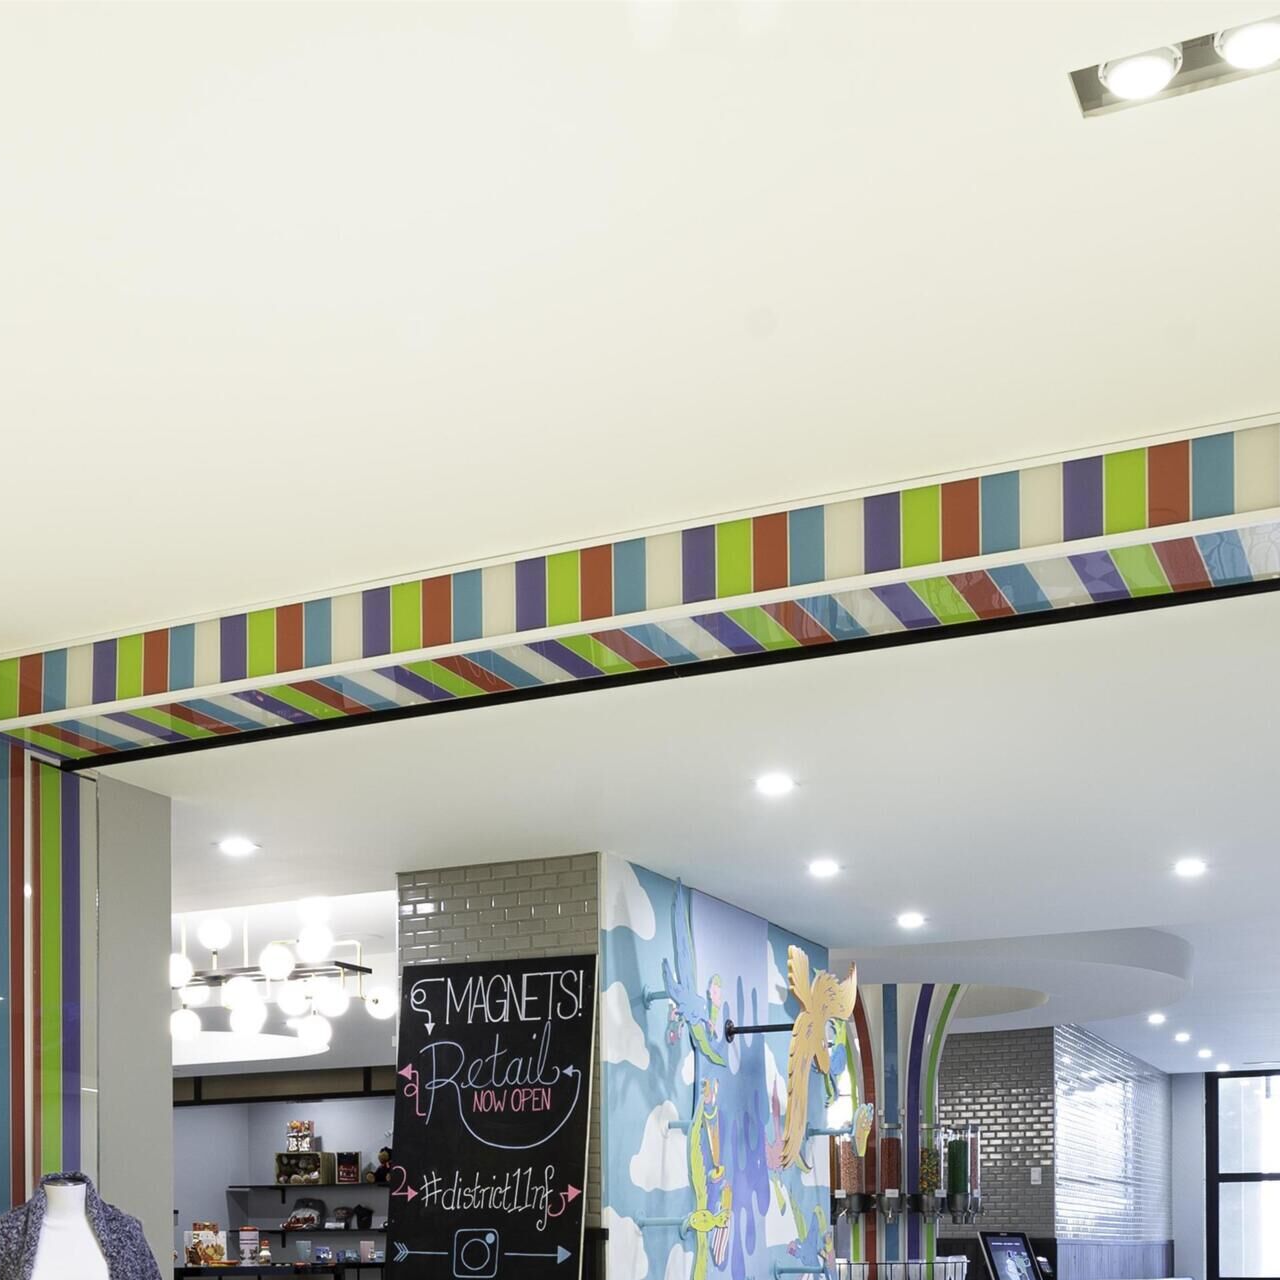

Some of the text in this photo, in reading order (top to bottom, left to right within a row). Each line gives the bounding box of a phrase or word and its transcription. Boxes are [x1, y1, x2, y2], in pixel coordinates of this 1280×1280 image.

[445, 969, 584, 1024] MAGNETS!
[419, 1021, 562, 1125] Retail
[473, 1088, 552, 1112] NOW OPEN
